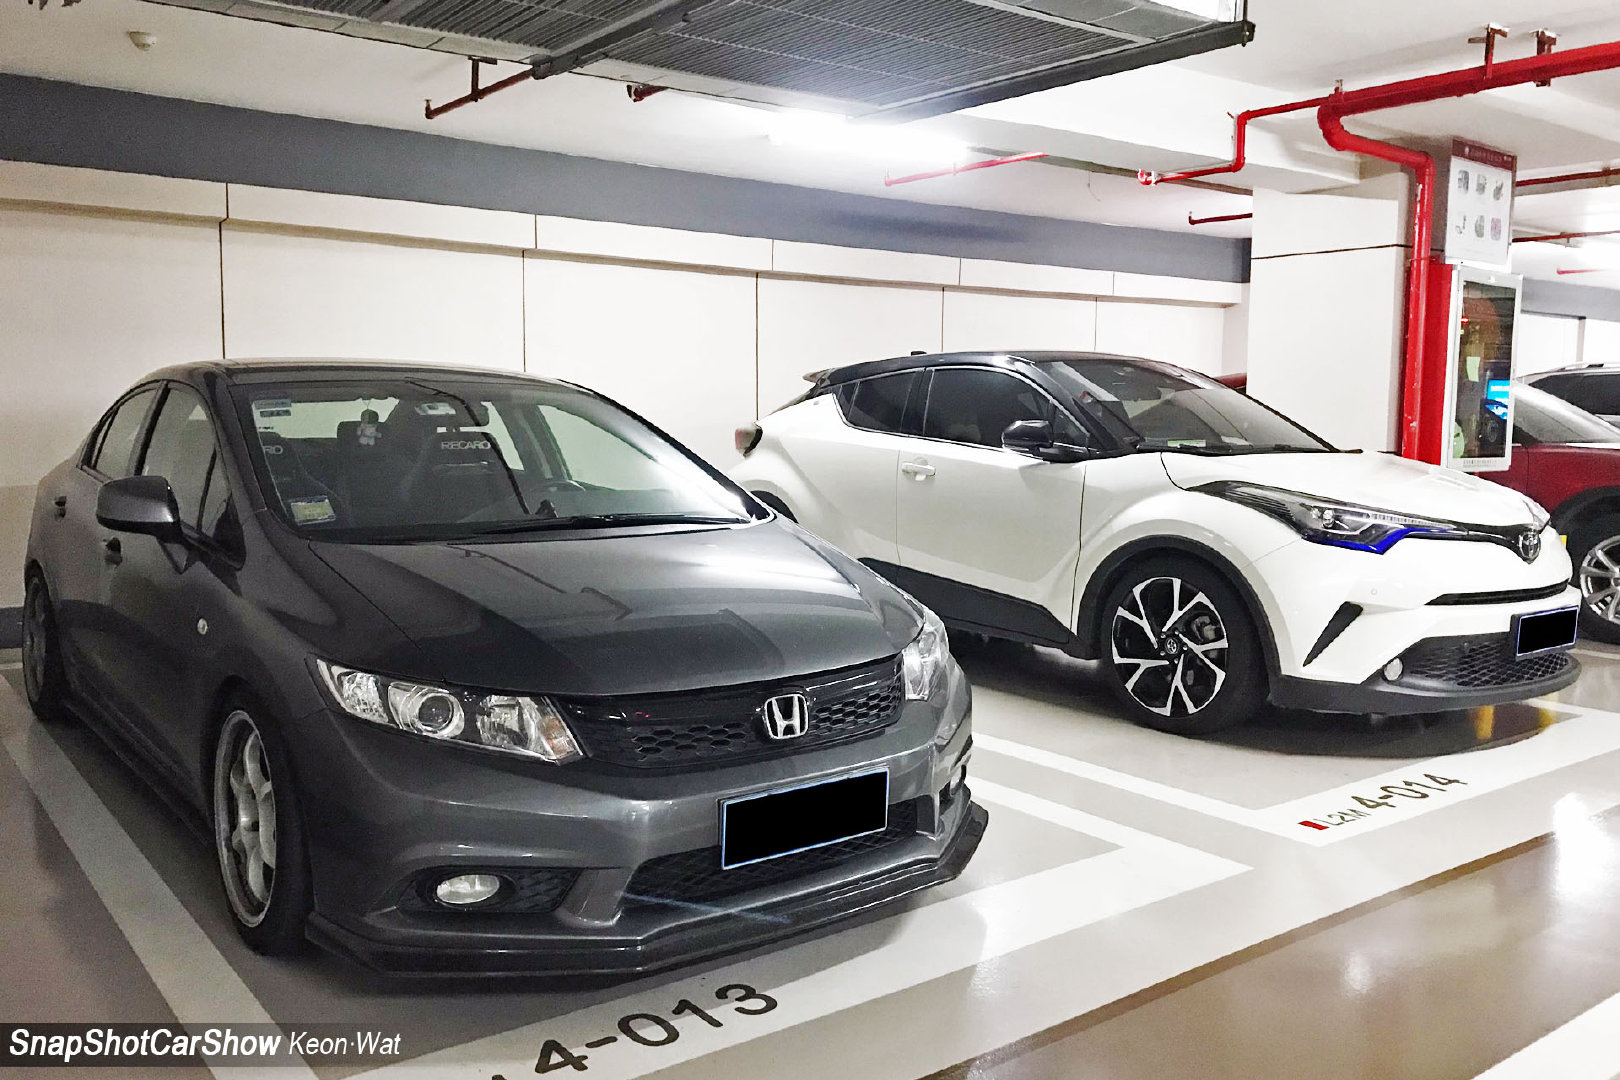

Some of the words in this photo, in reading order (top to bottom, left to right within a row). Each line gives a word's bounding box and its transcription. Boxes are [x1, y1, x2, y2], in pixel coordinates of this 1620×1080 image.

[441, 440, 491, 450] RECARO
[1351, 773, 1468, 809] 4-014
[534, 983, 779, 1073] 4-013
